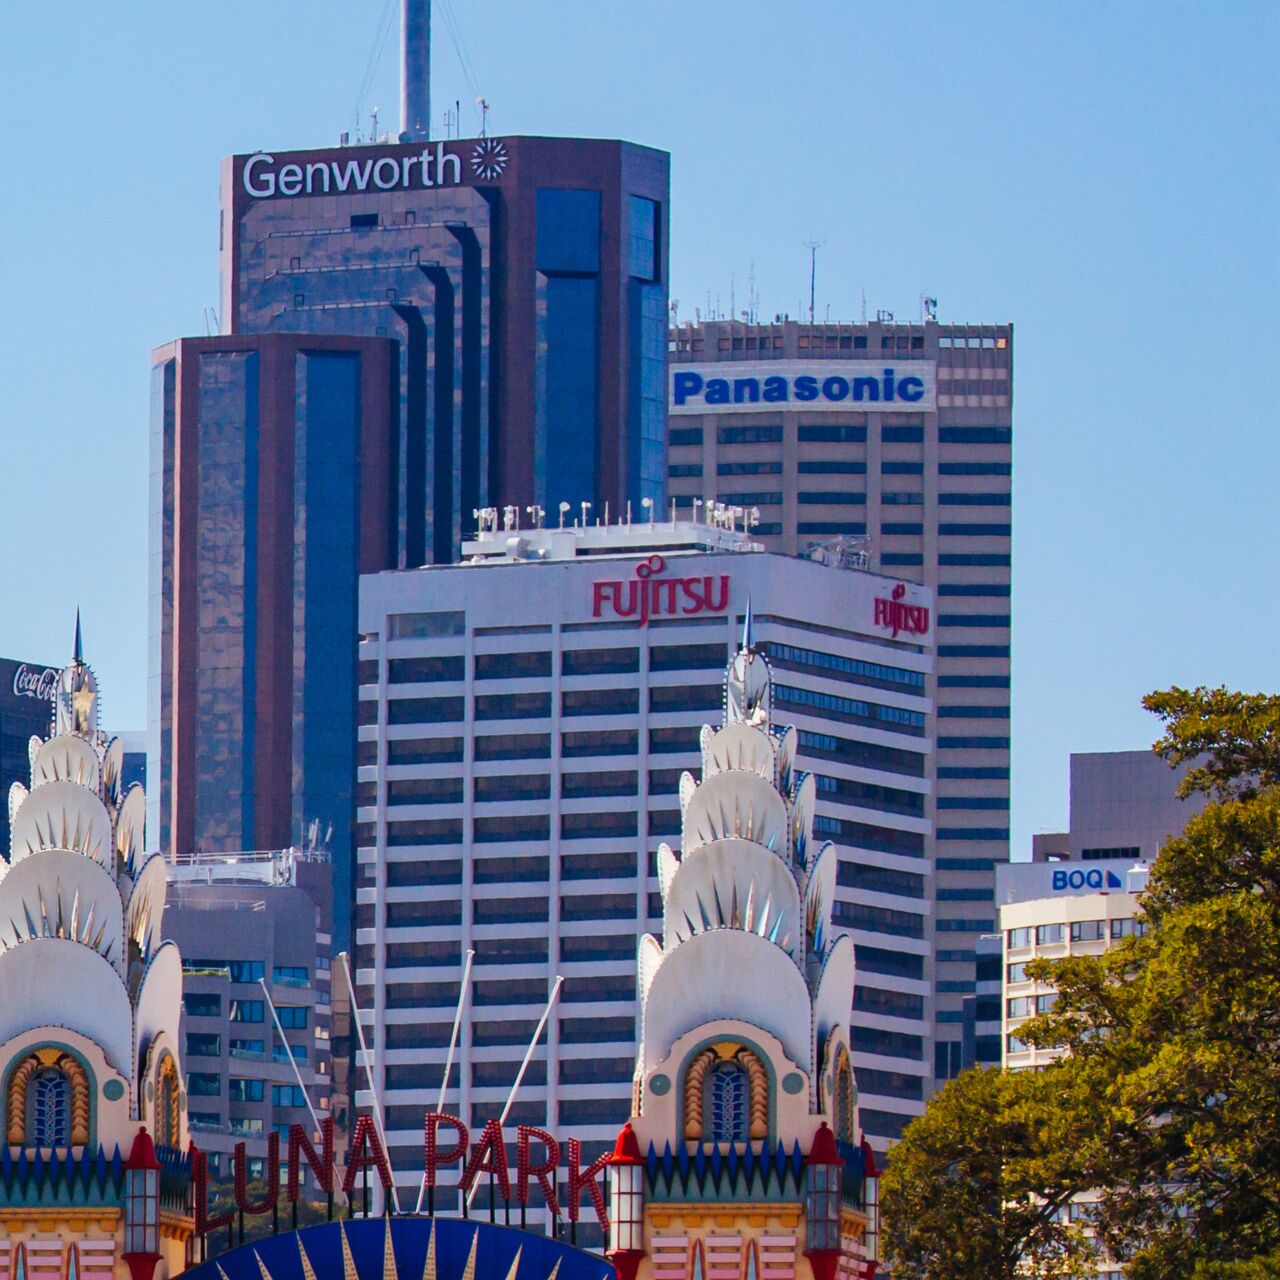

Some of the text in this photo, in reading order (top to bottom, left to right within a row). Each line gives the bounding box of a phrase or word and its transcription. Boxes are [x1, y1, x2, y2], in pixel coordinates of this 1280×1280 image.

[243, 142, 461, 197] Genworth
[673, 368, 924, 405] Panasonic
[592, 555, 730, 628] FUJITSU
[873, 582, 930, 638] FUJITSU
[1052, 868, 1103, 890] BOQ
[195, 1112, 614, 1237] LUNA PARK
